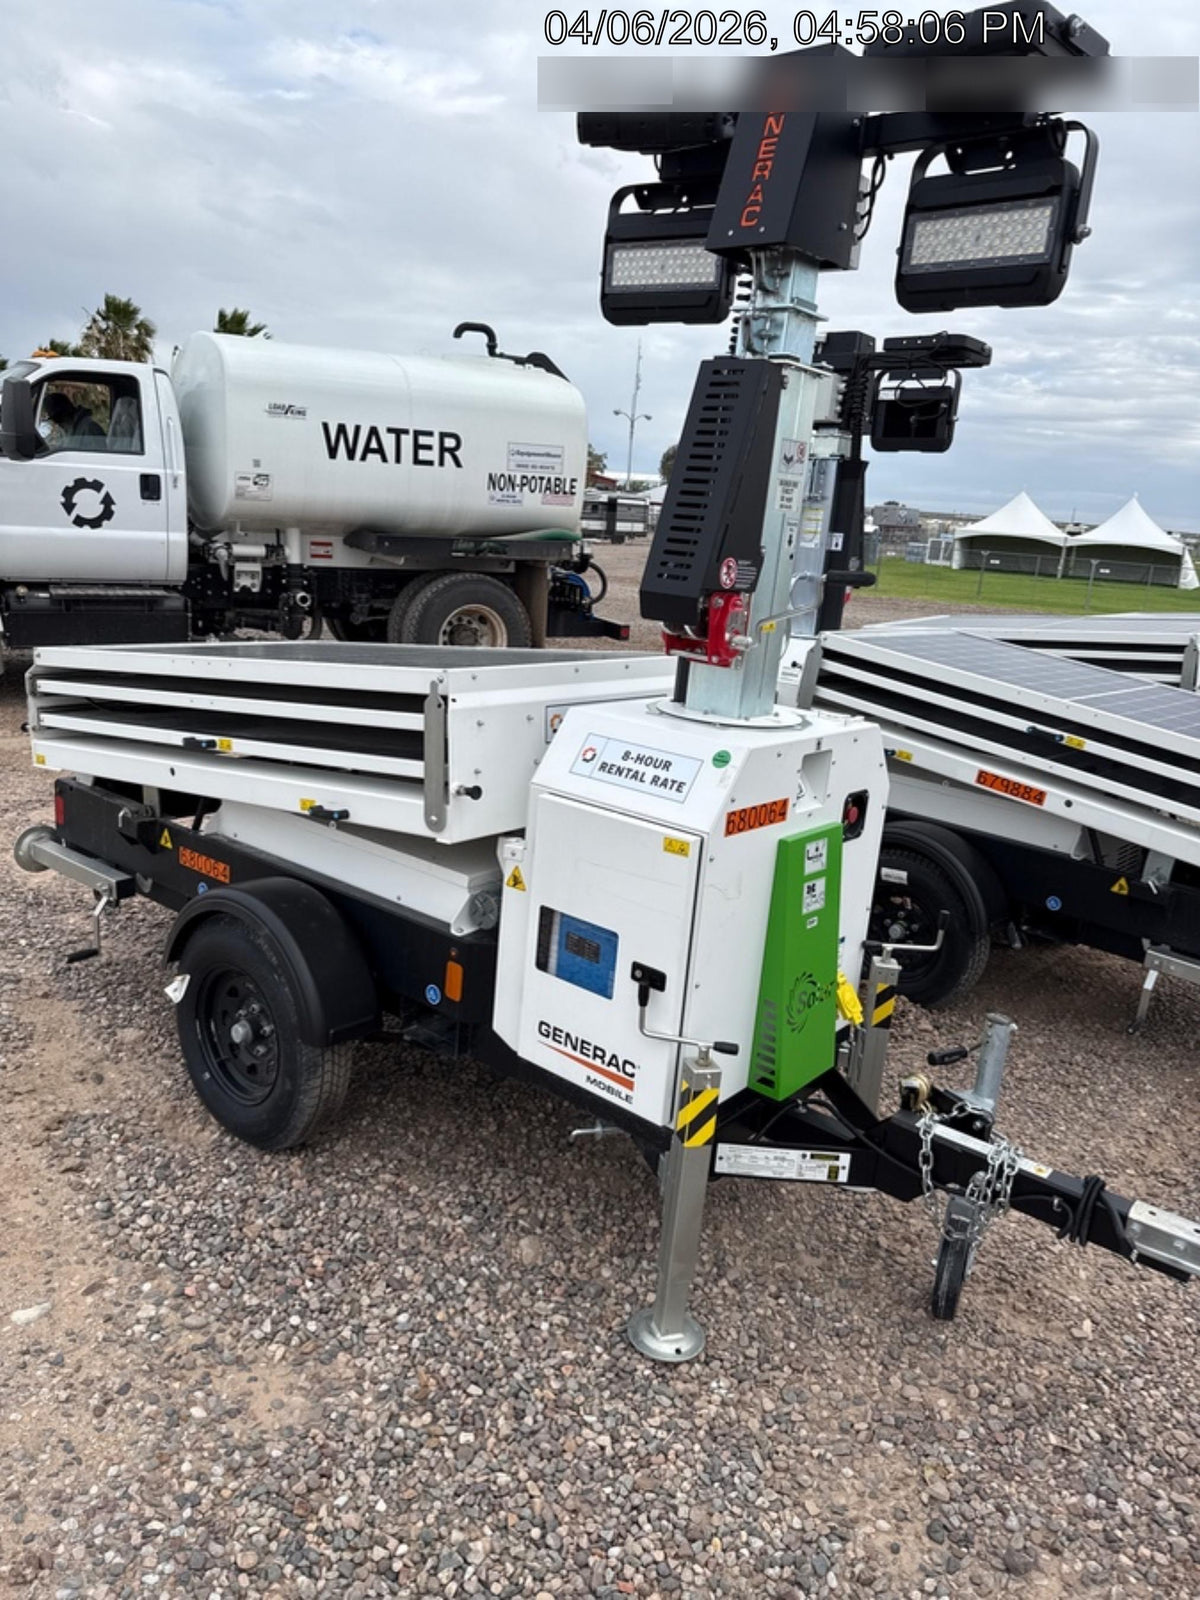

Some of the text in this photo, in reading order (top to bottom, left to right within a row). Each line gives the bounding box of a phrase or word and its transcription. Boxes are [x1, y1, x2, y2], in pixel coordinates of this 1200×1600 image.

[740, 112, 786, 227] NERAC
[321, 421, 464, 469] WATER
[487, 472, 578, 495] NON-POTABLE
[597, 762, 687, 794] RENTAL RATE
[621, 750, 673, 772] 8-HOUR
[978, 770, 1046, 805] 679884
[726, 797, 789, 835] 680064
[537, 1020, 637, 1078] GENERAC
[585, 1075, 634, 1105] MOBILE
